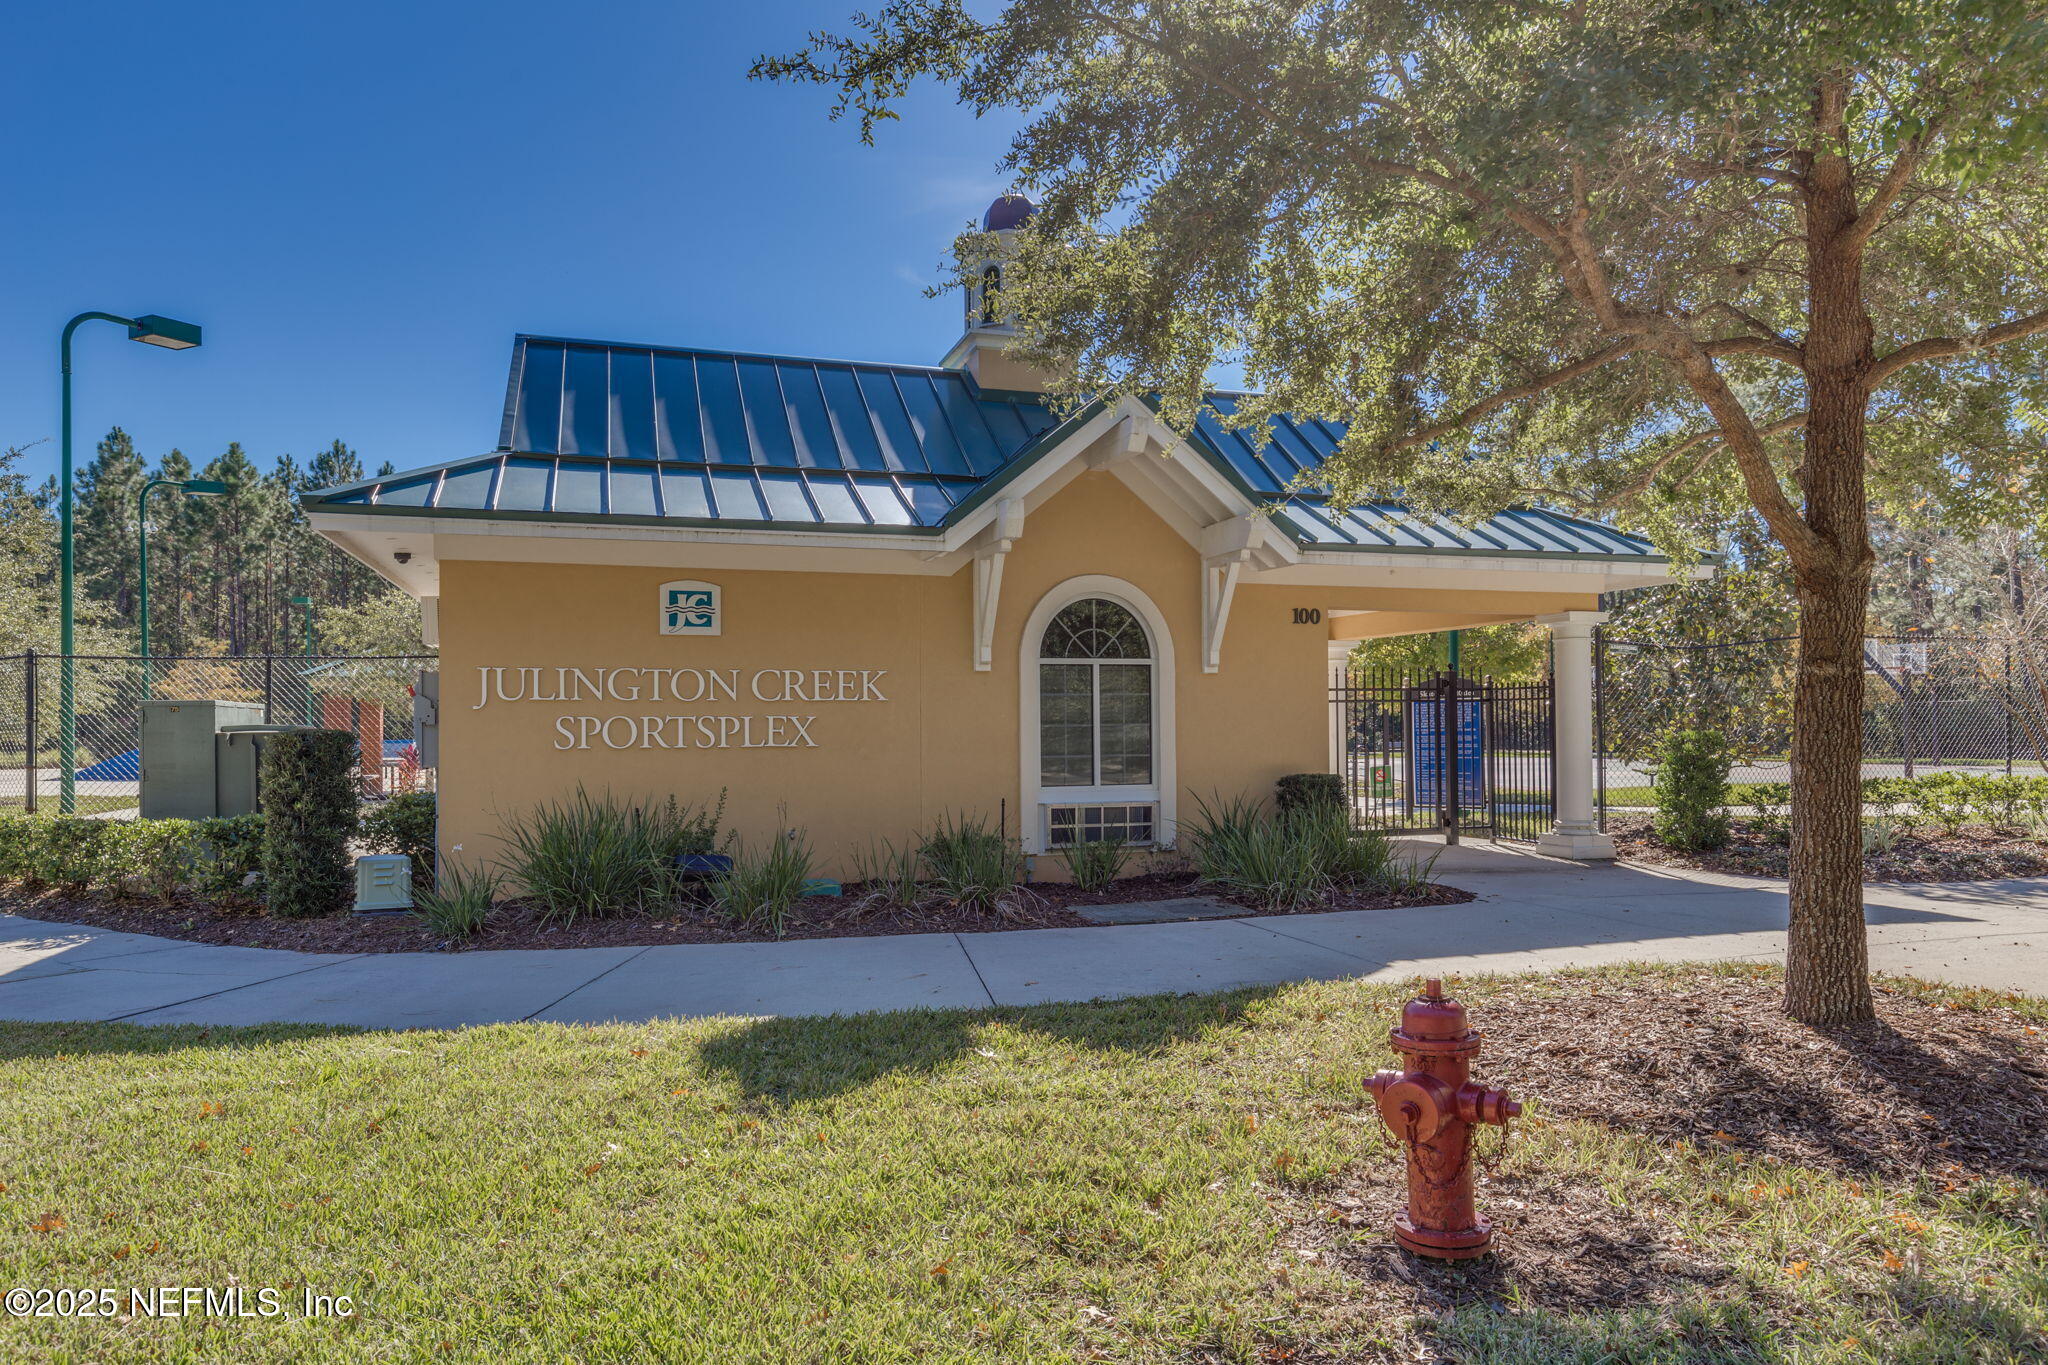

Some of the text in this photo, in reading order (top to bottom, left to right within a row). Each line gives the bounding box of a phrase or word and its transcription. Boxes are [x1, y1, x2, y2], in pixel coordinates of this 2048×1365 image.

[669, 593, 708, 633] JC
[1292, 607, 1321, 625] 100
[472, 666, 888, 710] JULINGTON CREEK
[553, 715, 819, 750] SPORTSPLEX
